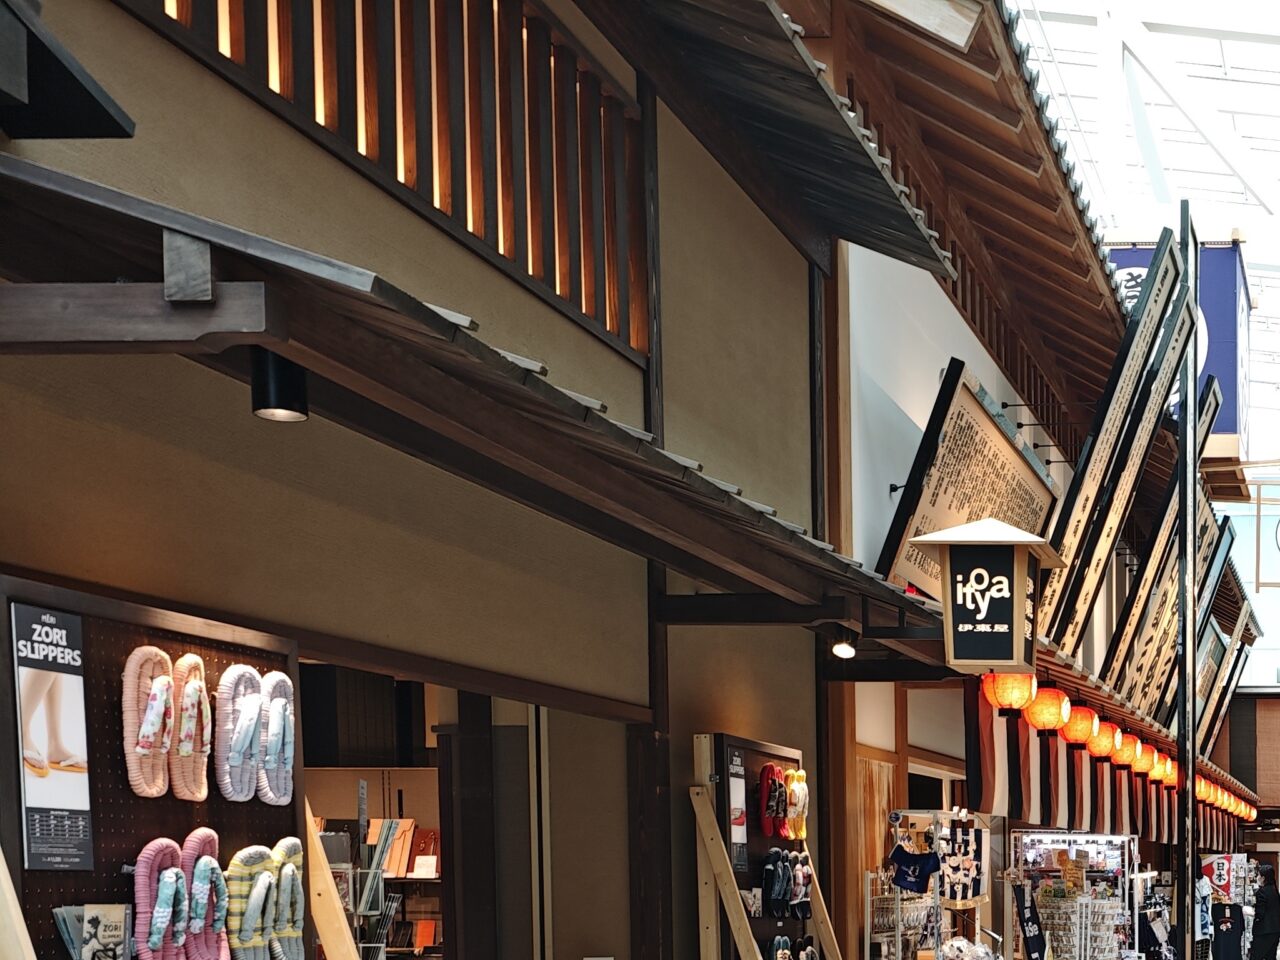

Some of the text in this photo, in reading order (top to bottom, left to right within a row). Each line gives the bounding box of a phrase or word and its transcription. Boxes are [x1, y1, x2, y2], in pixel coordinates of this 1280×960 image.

[31, 623, 68, 647] ZORI
[17, 639, 82, 667] SLIPPERS
[1215, 861, 1227, 883] 日本
[102, 924, 122, 933] ZORI
